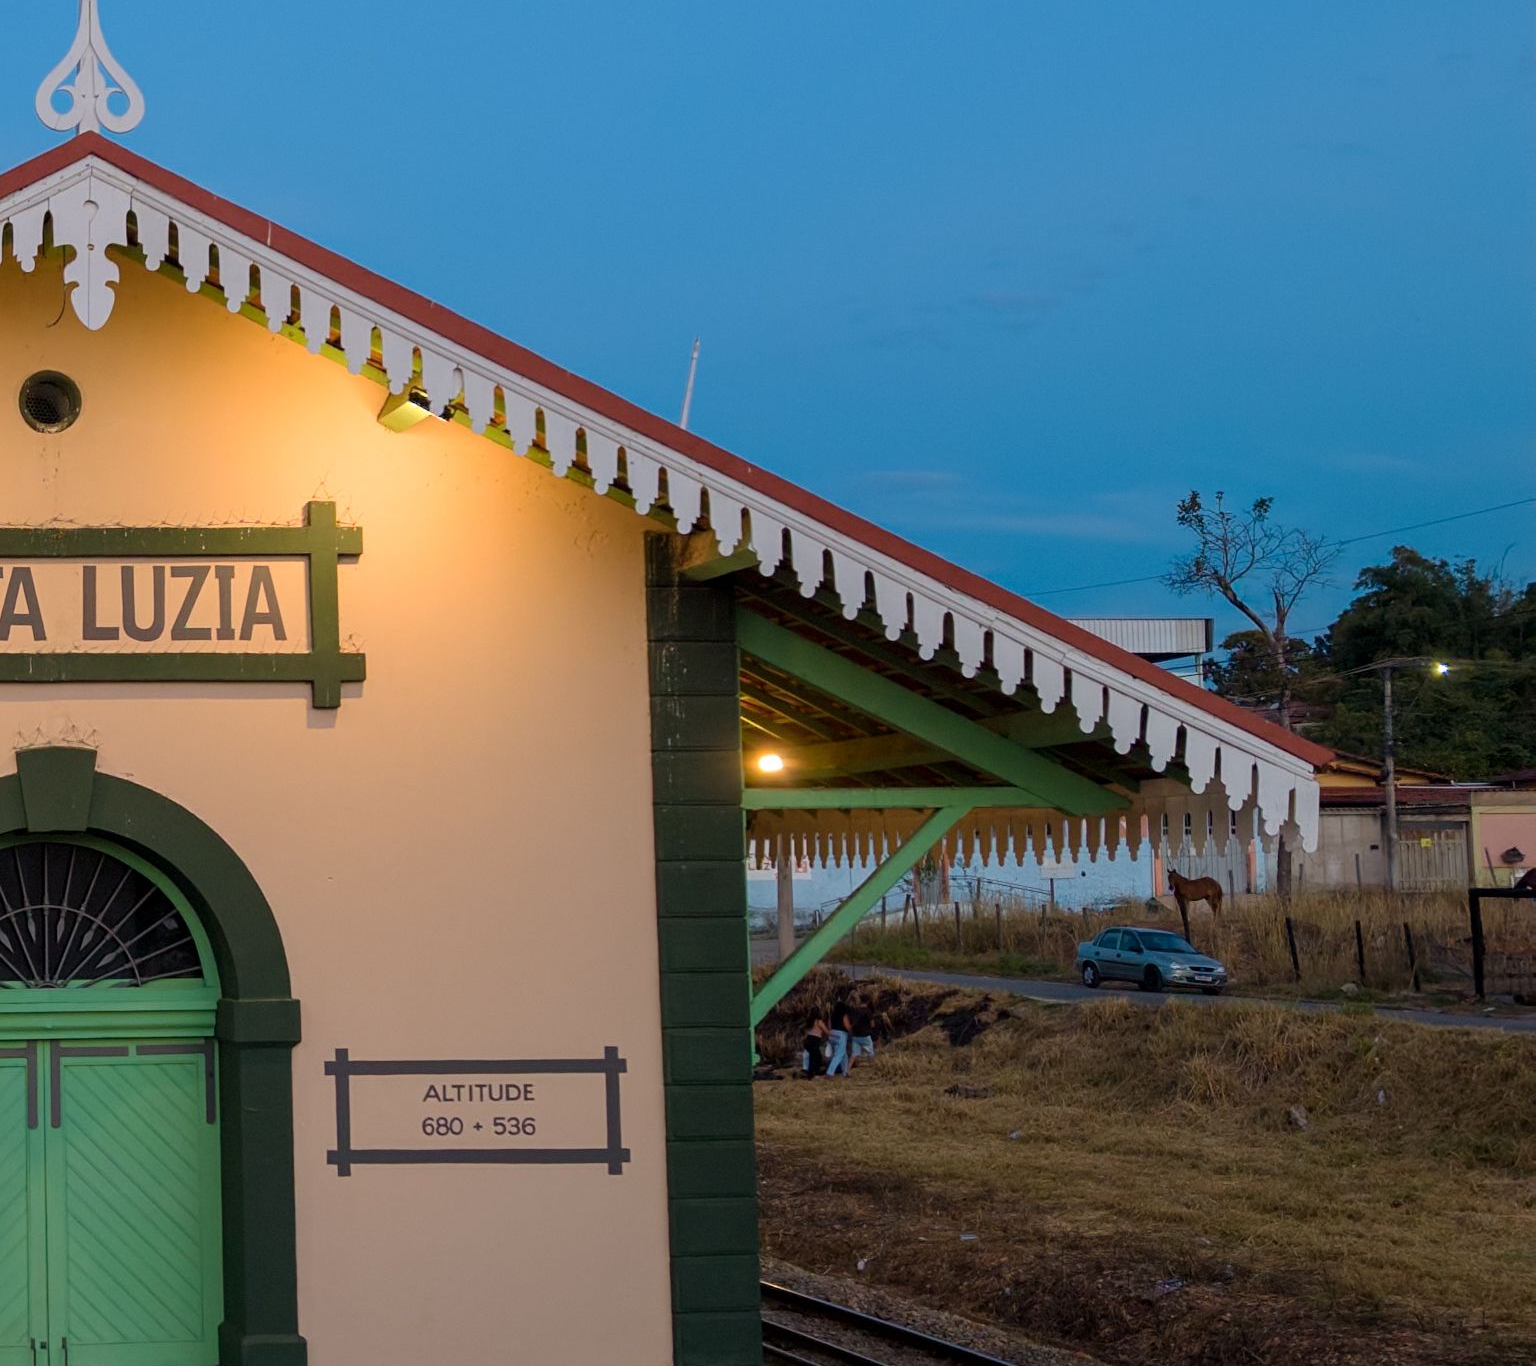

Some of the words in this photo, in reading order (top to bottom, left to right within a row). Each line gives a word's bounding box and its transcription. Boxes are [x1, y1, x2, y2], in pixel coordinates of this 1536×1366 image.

[82, 565, 288, 641] LUZIA
[422, 1083, 536, 1103] ALTITUDE
[421, 1117, 464, 1137] 680
[472, 1121, 484, 1132] +
[493, 1116, 536, 1136] 536
